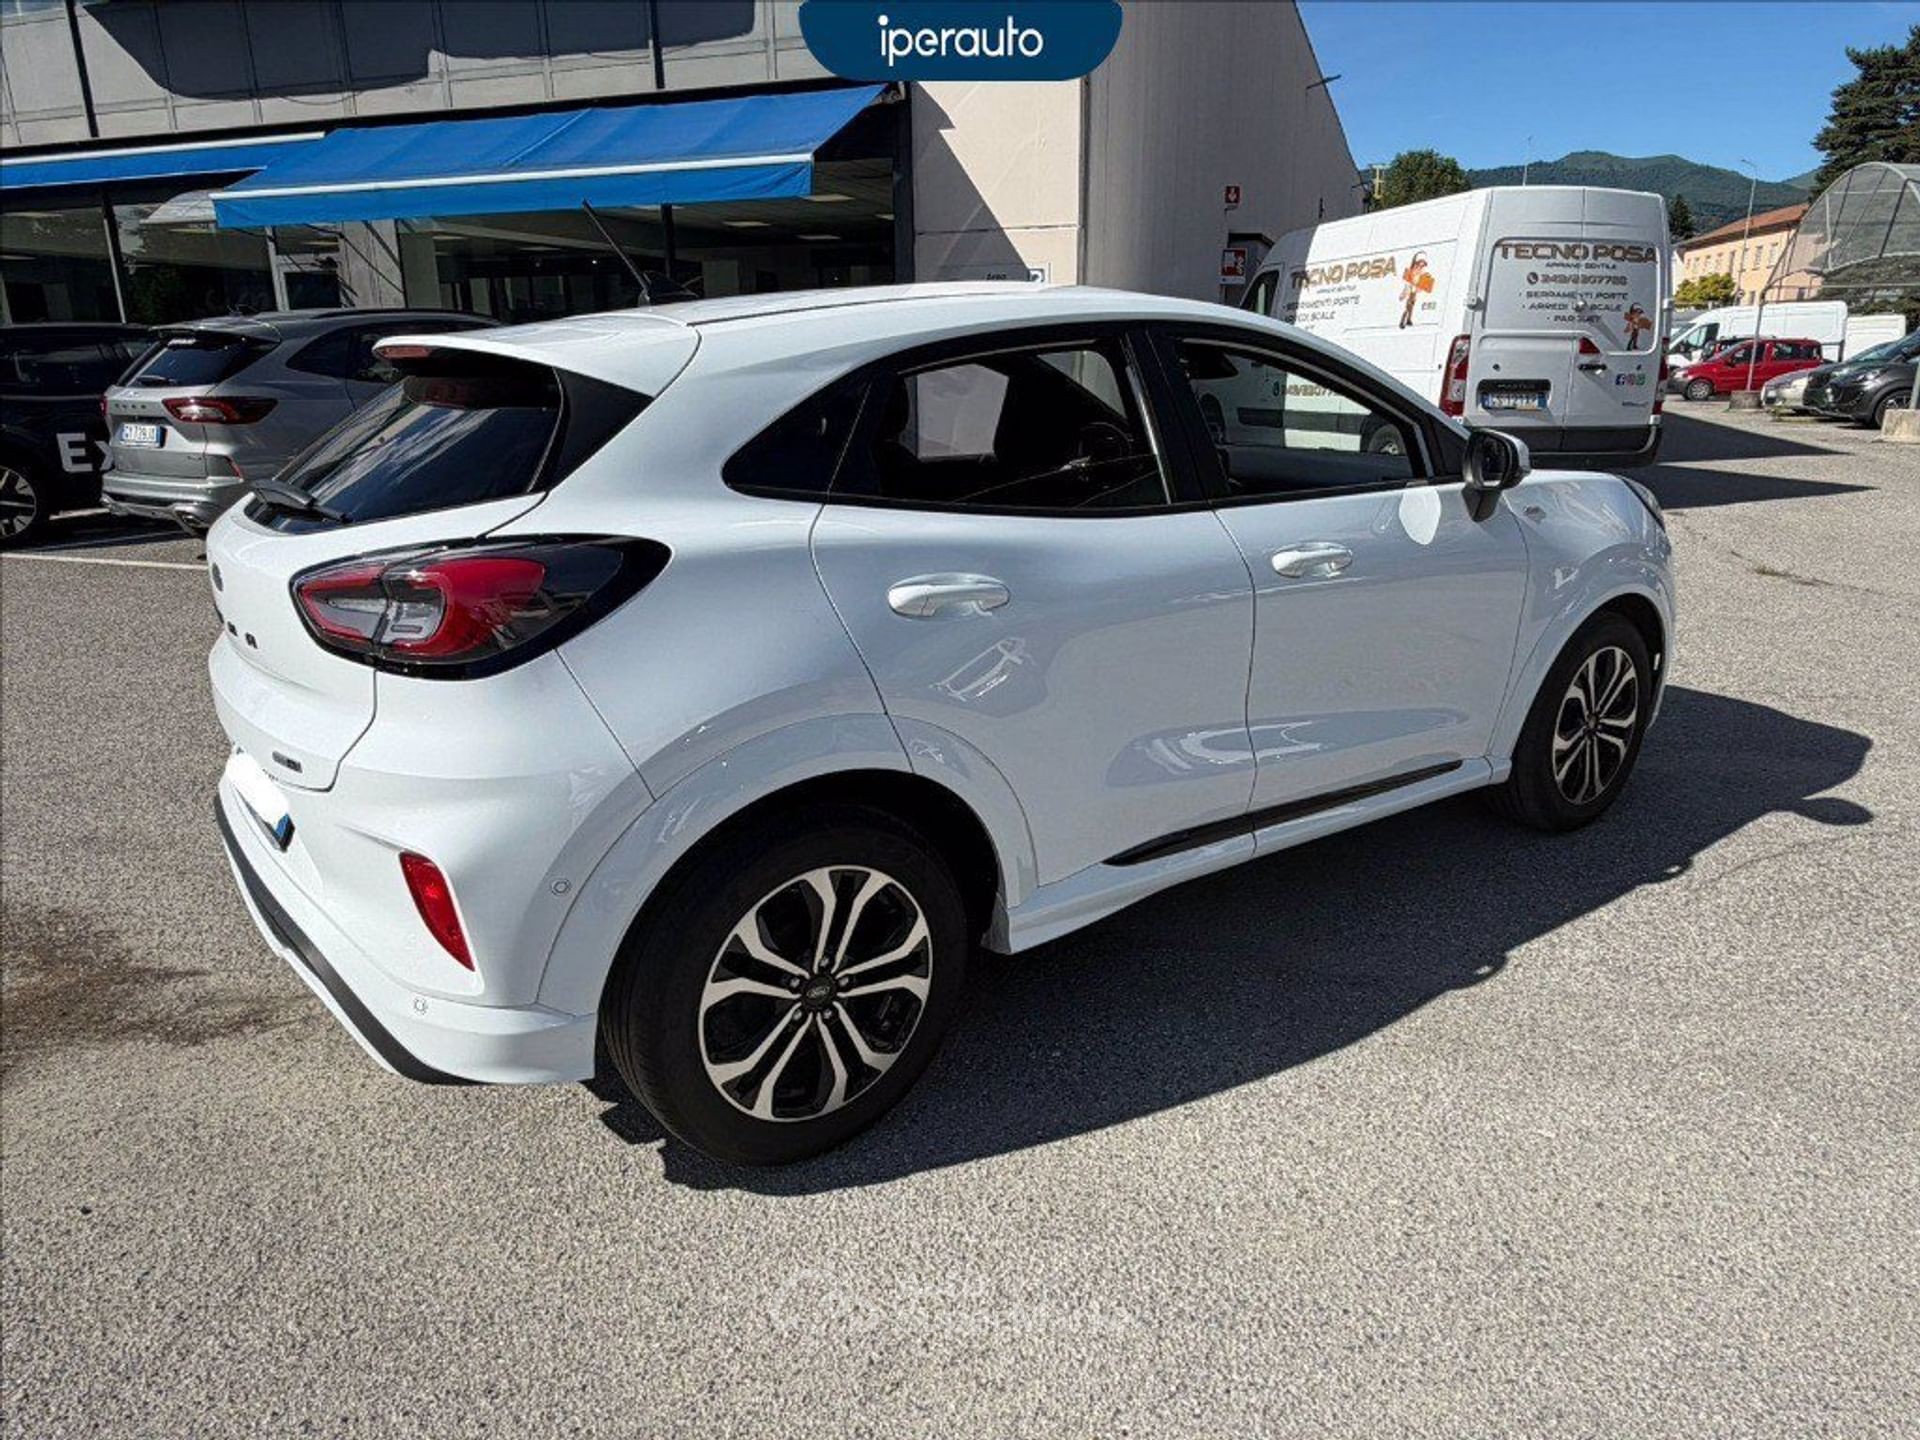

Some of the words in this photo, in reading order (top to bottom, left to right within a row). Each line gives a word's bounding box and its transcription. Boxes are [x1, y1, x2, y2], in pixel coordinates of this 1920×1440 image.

[1500, 243, 1589, 261] TECNO
[1592, 245, 1658, 264] POSA
[1345, 256, 1397, 283] POSA
